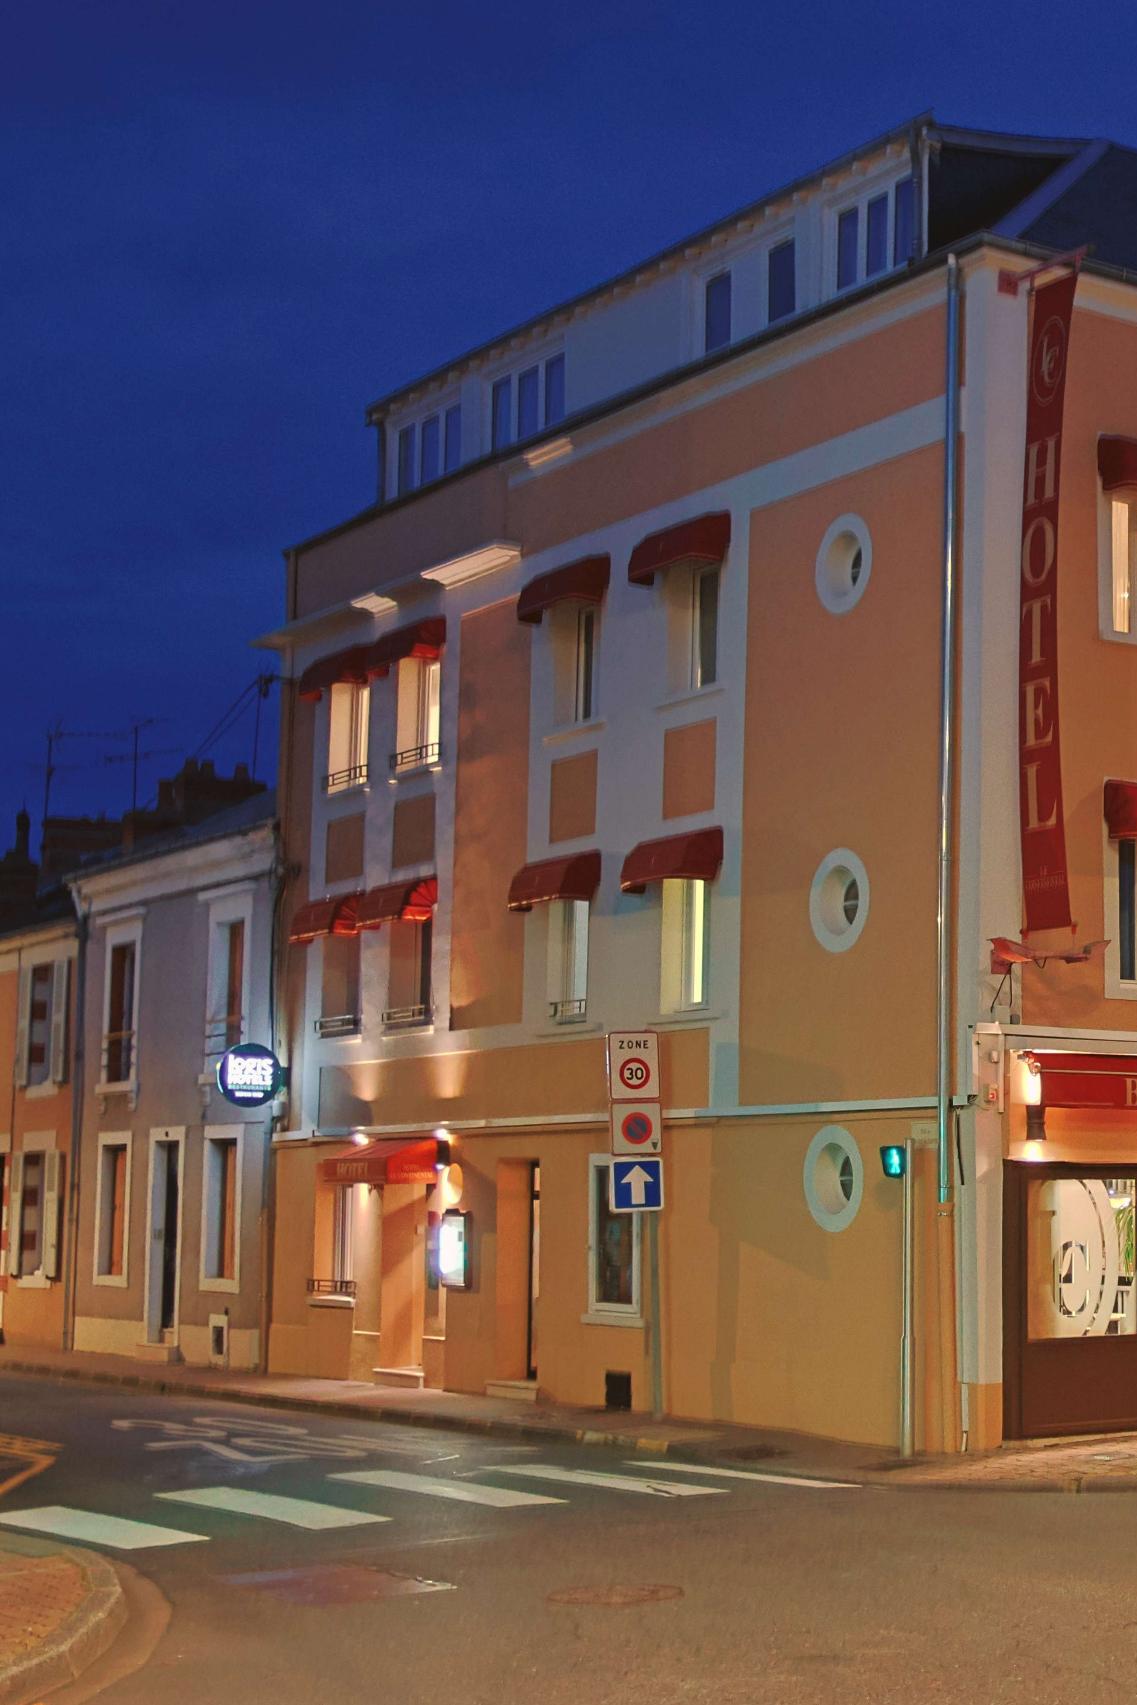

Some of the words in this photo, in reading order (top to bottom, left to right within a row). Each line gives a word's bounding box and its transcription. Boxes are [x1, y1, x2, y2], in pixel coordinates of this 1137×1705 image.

[1022, 433, 1061, 833] HOTEL
[618, 1040, 649, 1050] ZONE
[625, 1067, 645, 1081] 30
[336, 1160, 368, 1179] HOTEL
